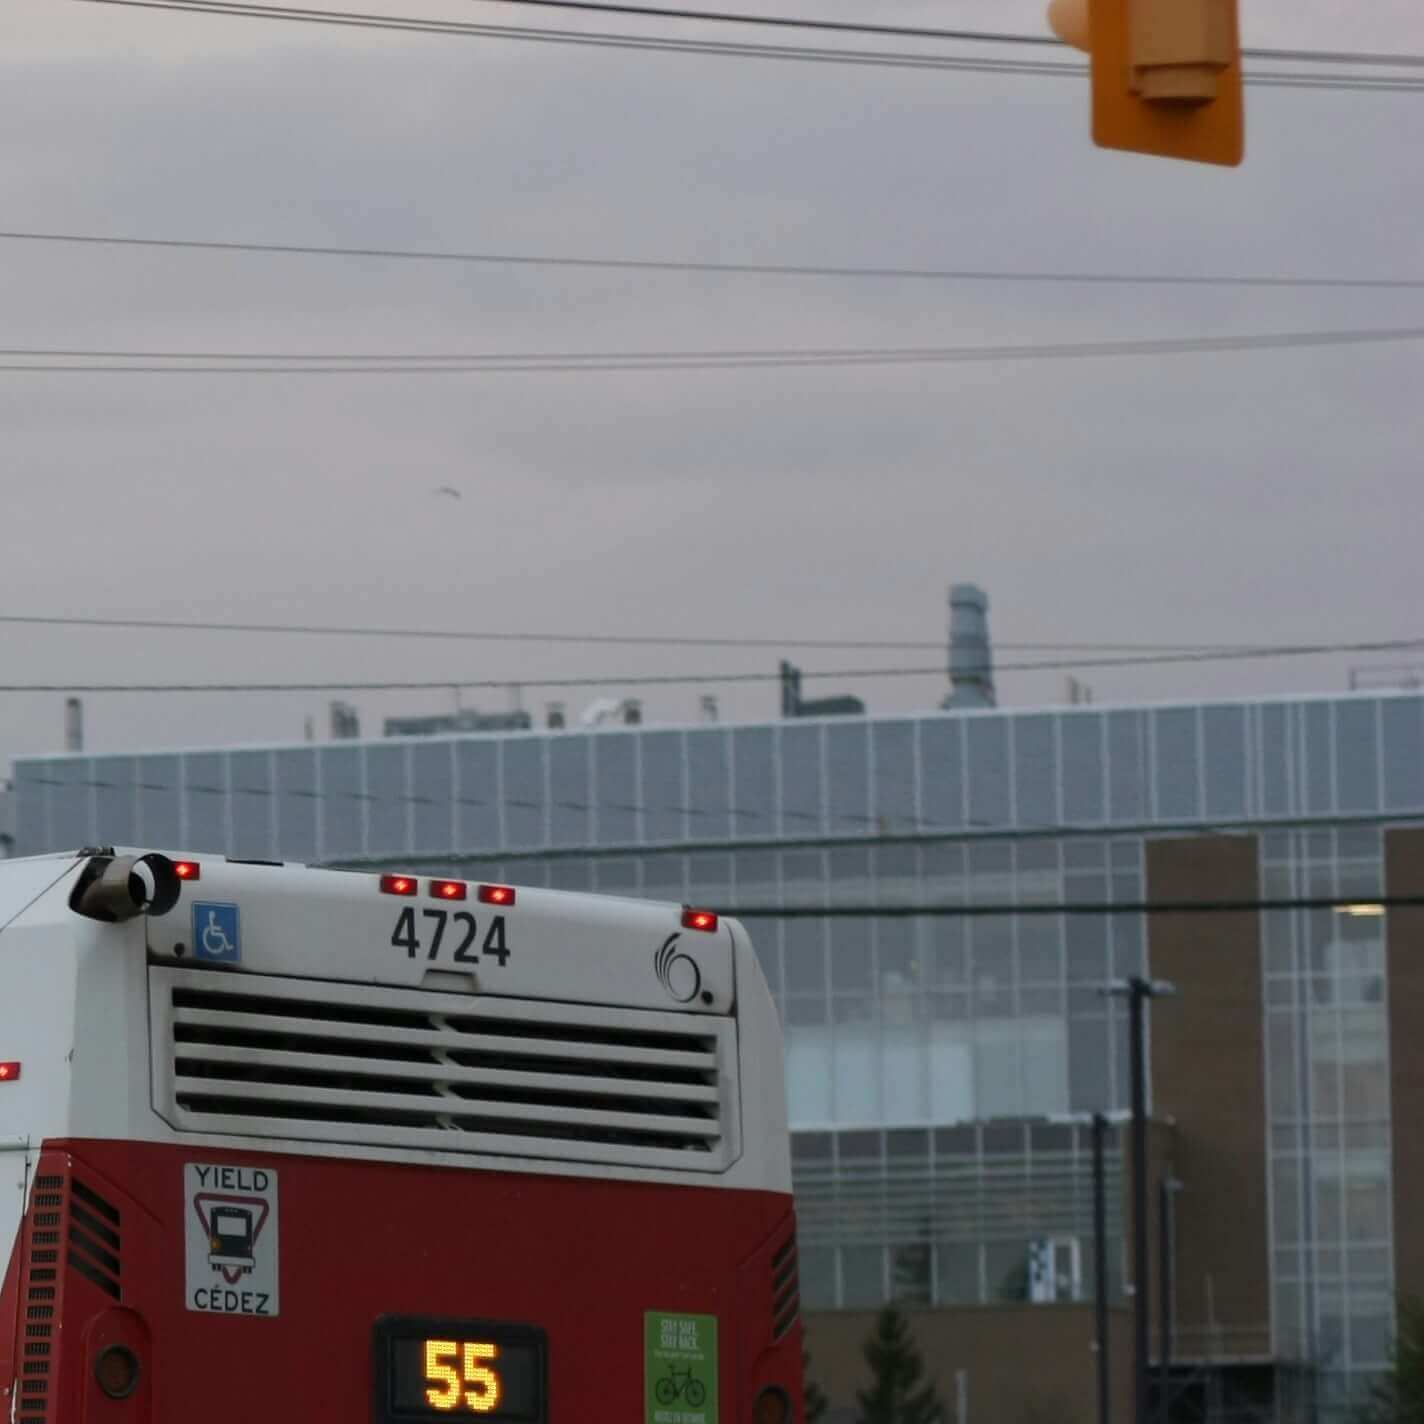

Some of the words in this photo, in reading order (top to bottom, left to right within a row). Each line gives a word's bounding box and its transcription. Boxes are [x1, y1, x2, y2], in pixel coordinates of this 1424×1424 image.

[391, 907, 511, 967] 4724
[194, 1167, 269, 1192] YIELD
[193, 1285, 270, 1314] CÉDEZ
[424, 1339, 498, 1411] 55
